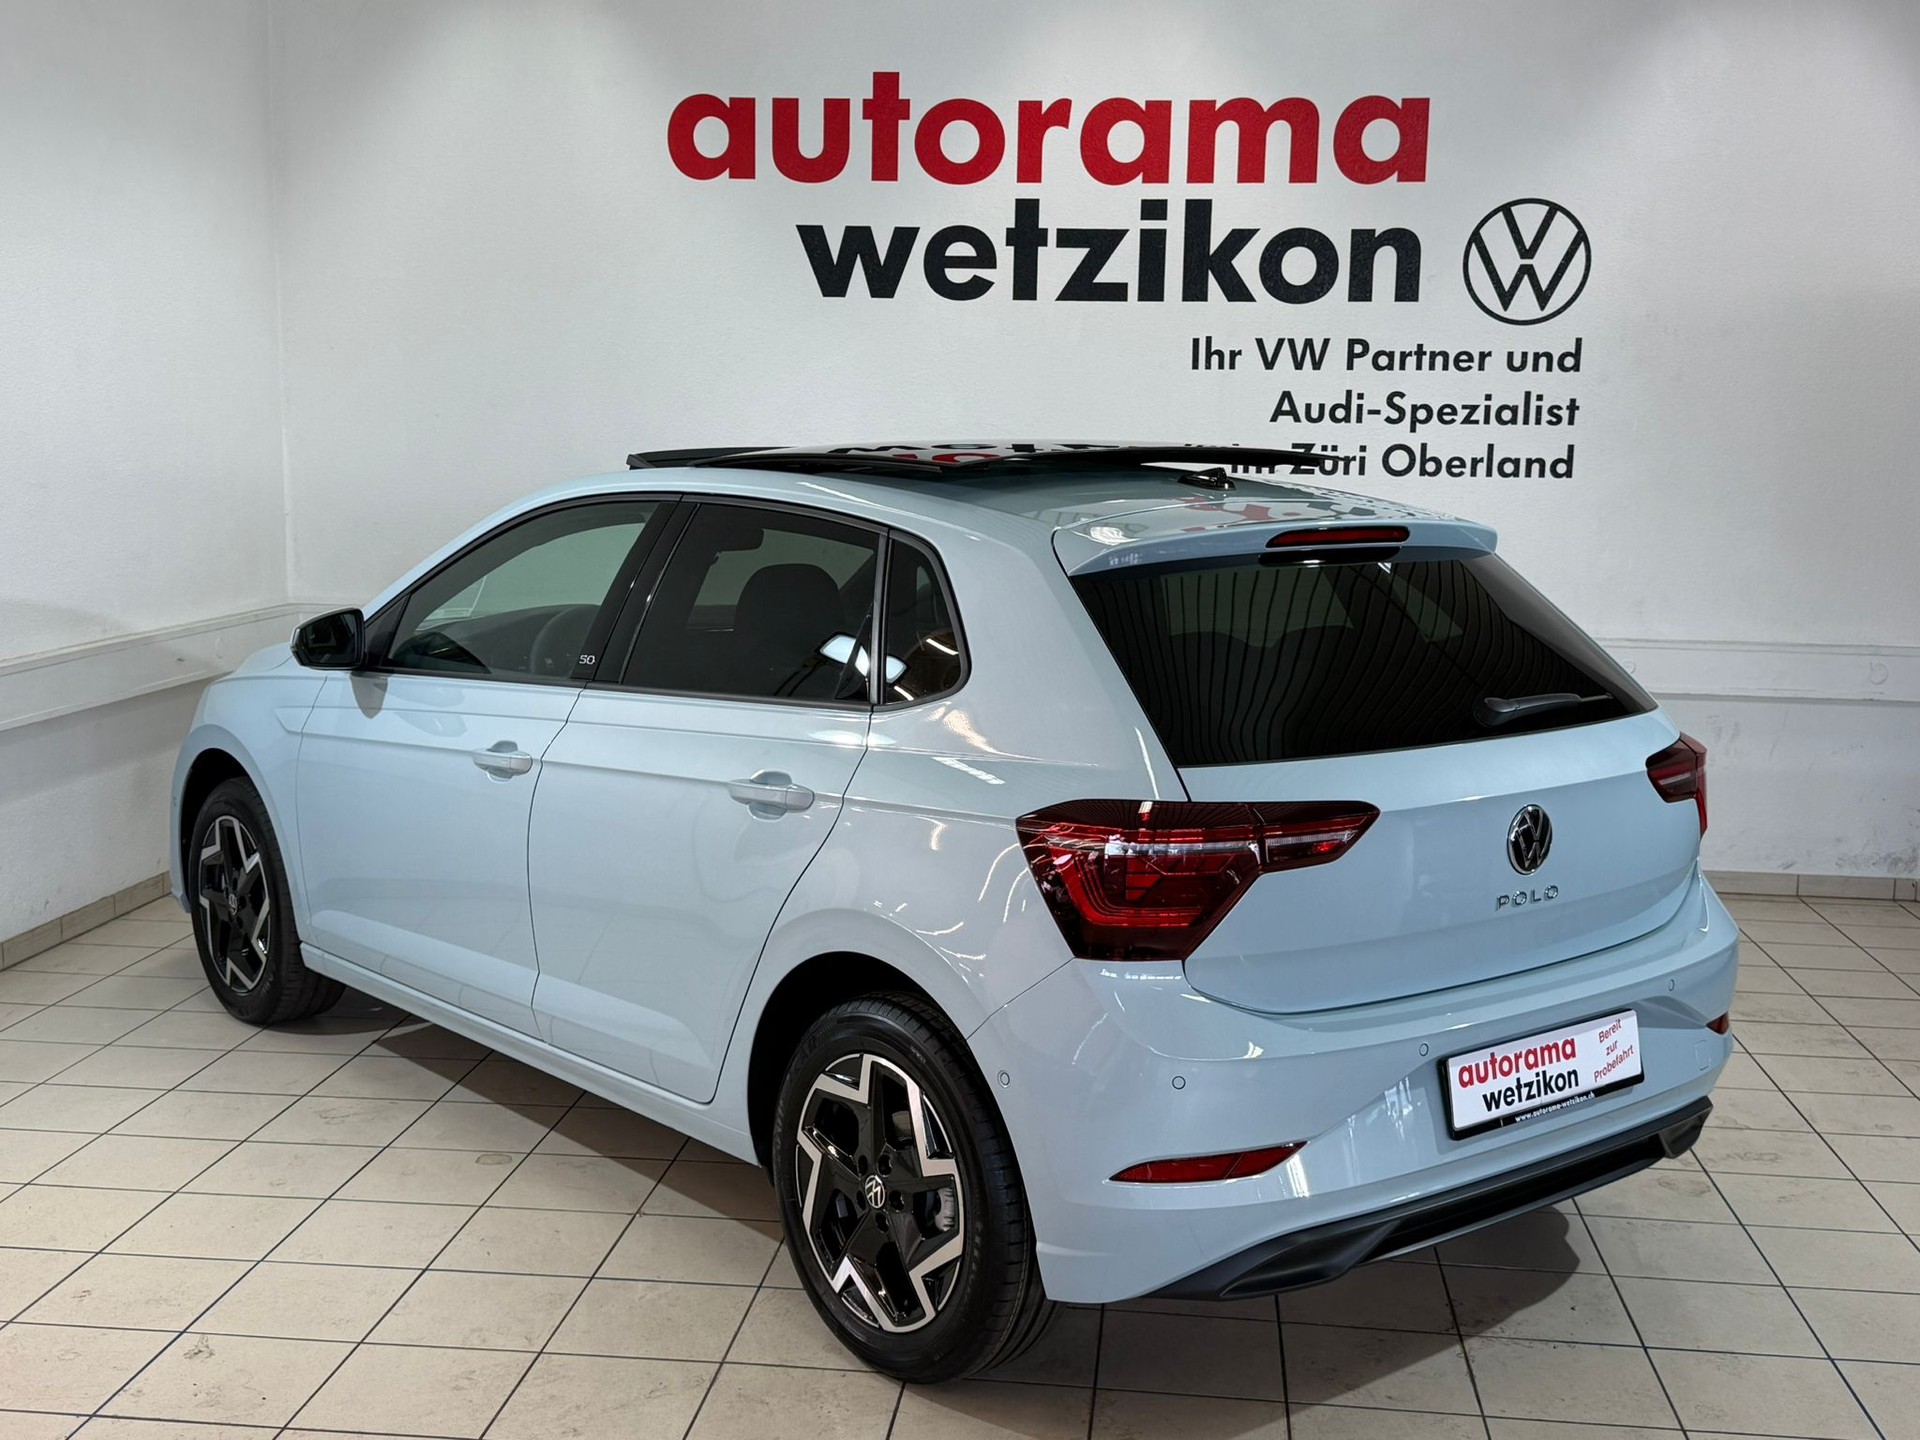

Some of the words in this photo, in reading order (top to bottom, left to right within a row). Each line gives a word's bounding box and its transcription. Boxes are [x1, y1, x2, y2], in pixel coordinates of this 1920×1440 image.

[669, 72, 1430, 186] autorama
[796, 198, 1422, 305] wetzikon
[1191, 335, 1242, 371] Ihr
[1255, 337, 1331, 372] VW
[1346, 338, 1492, 372] Partner
[1506, 337, 1583, 373] und
[1270, 389, 1580, 433] Audi-Spezialist
[1381, 442, 1575, 479] Oberland
[1496, 885, 1559, 910] POLO
[1598, 1018, 1622, 1043] Bereit
[1605, 1040, 1618, 1056] zur
[1458, 1037, 1577, 1089] autorama
[1593, 1044, 1634, 1083] Probefahrt
[1482, 1068, 1580, 1112] wetzikon
[1514, 1091, 1596, 1123] www.autorama-wetzikon.ch
